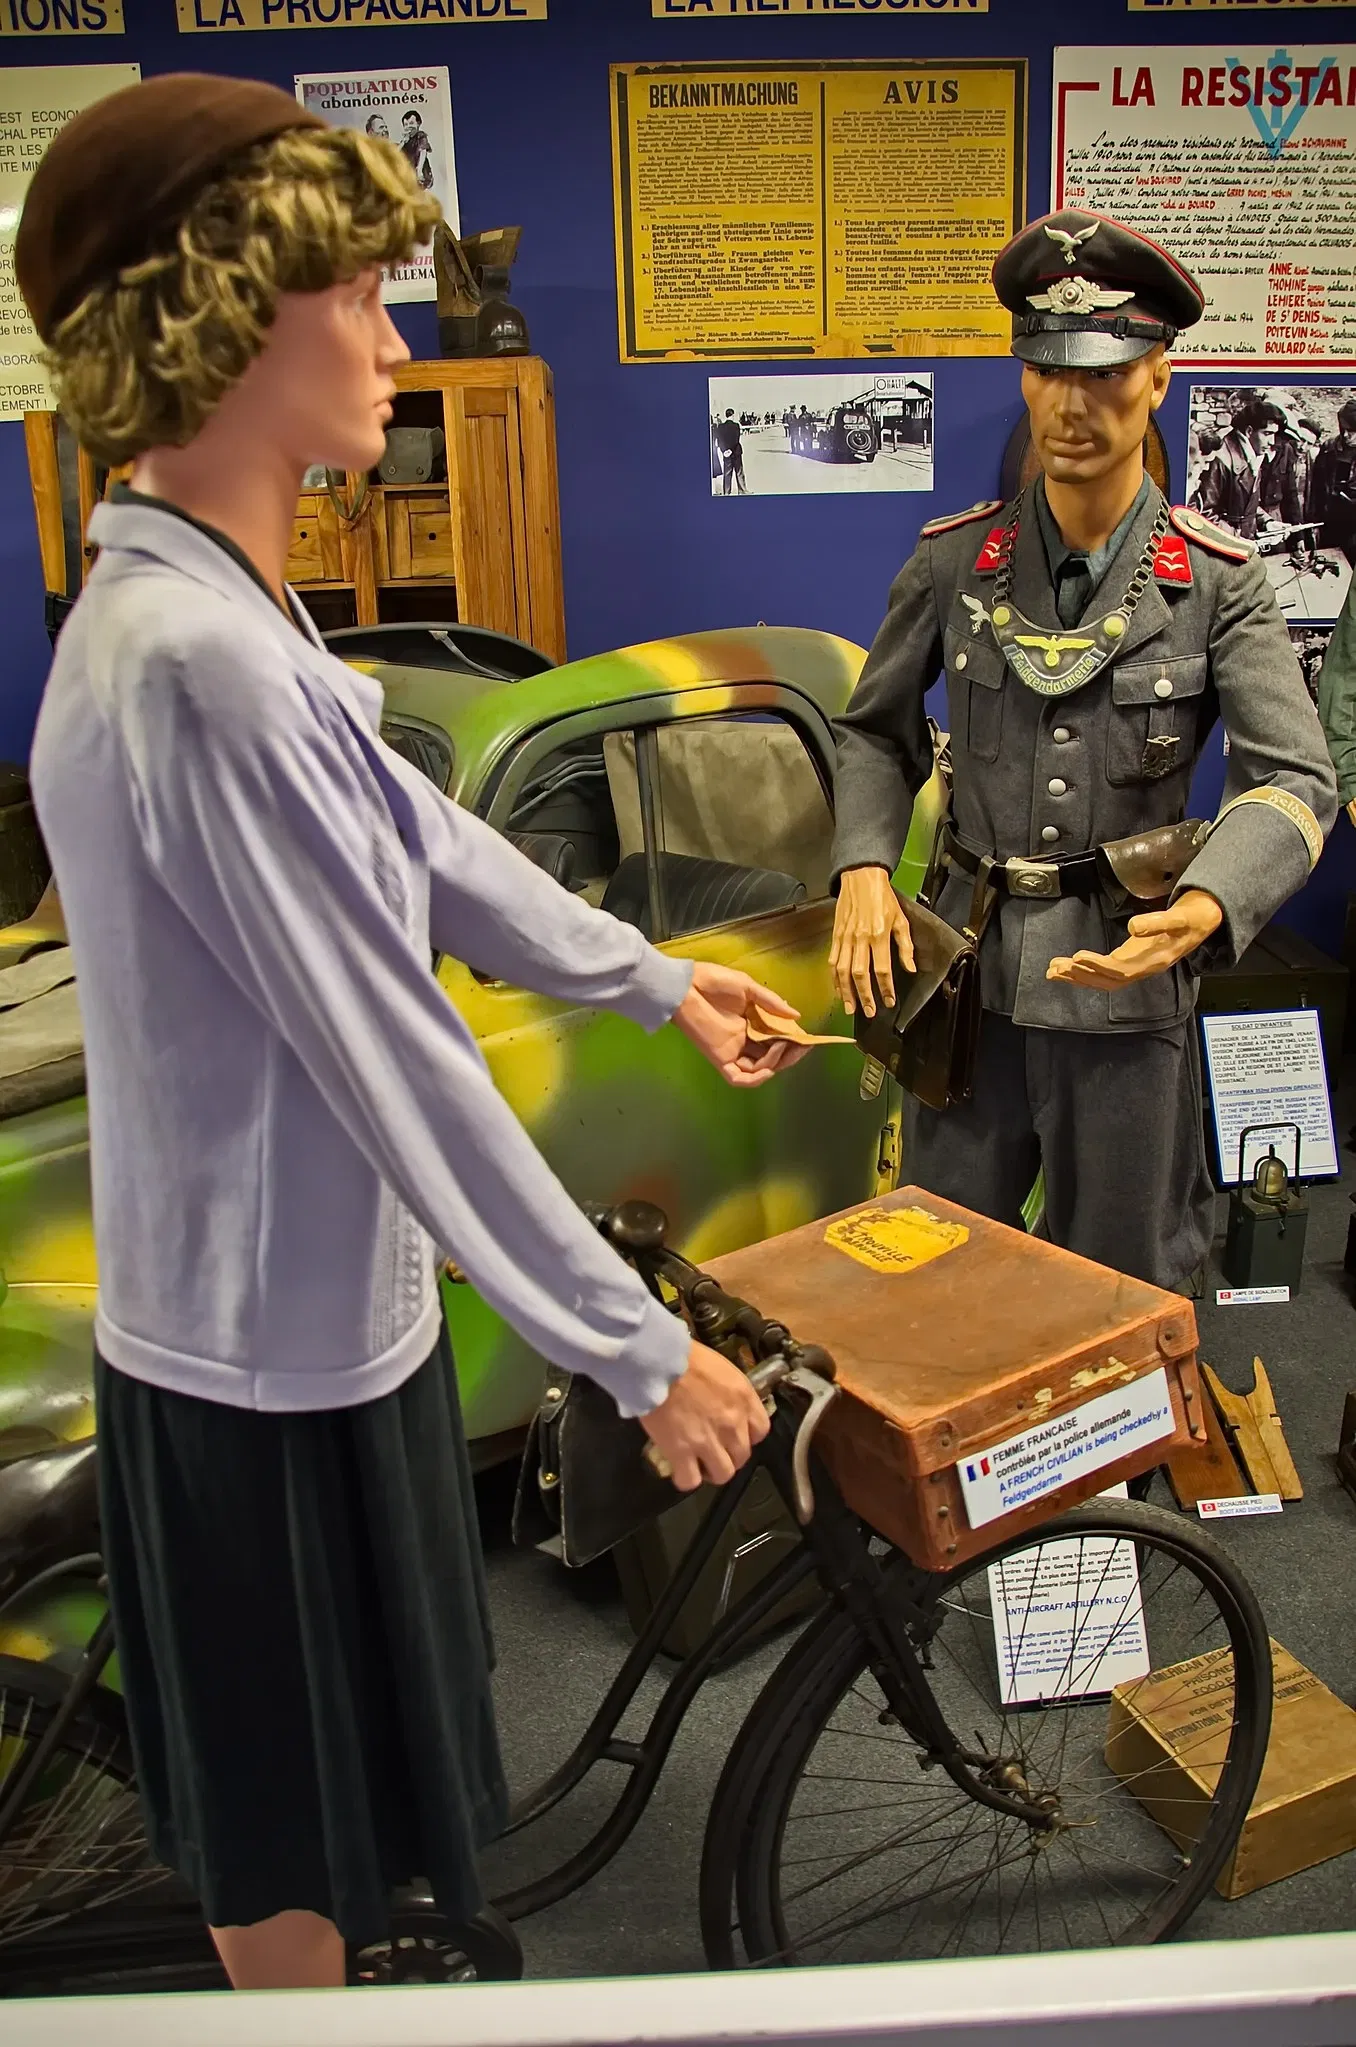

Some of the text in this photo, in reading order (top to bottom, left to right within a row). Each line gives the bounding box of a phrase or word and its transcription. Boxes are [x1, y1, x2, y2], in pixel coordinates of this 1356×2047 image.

[0, 0, 107, 30] IONS
[303, 77, 438, 98] POPULATIONS
[650, 80, 959, 108] BEKANNTMACHUNG AVIS
[1112, 67, 1155, 106] LA
[32, 110, 79, 122] ECONO
[31, 128, 64, 139] PETA
[20, 144, 42, 155] LES
[878, 219, 905, 227] proches
[908, 219, 934, 227] parents
[1268, 263, 1292, 275] ANNE
[1266, 310, 1276, 322] DE
[1293, 310, 1320, 322] DENIS
[14, 325, 32, 334] très
[1266, 326, 1308, 338] POITEVIN
[1265, 342, 1305, 354] BOULARD
[0, 399, 40, 411] EMENT
[1013, 653, 1094, 692] Feldgendarmerie
[993, 1417, 1079, 1464] FEMME FRANCAISE
[996, 1409, 1131, 1478] contrôlée par la police allemande
[999, 1483, 1006, 1493] A
[1008, 1466, 1044, 1489] FRENCH
[1047, 1447, 1084, 1469] CIVILIAN
[1086, 1442, 1093, 1451] is
[1094, 1431, 1117, 1449] being
[1163, 1407, 1168, 1415] a
[1002, 1473, 1063, 1507] Feldgendarme
[1006, 1603, 1063, 1616] ANTI-AIRCRAFT
[1065, 1599, 1104, 1609] ARTILLERY
[1273, 1669, 1307, 1684] HROUGH
[1193, 1679, 1224, 1696] FOOD
